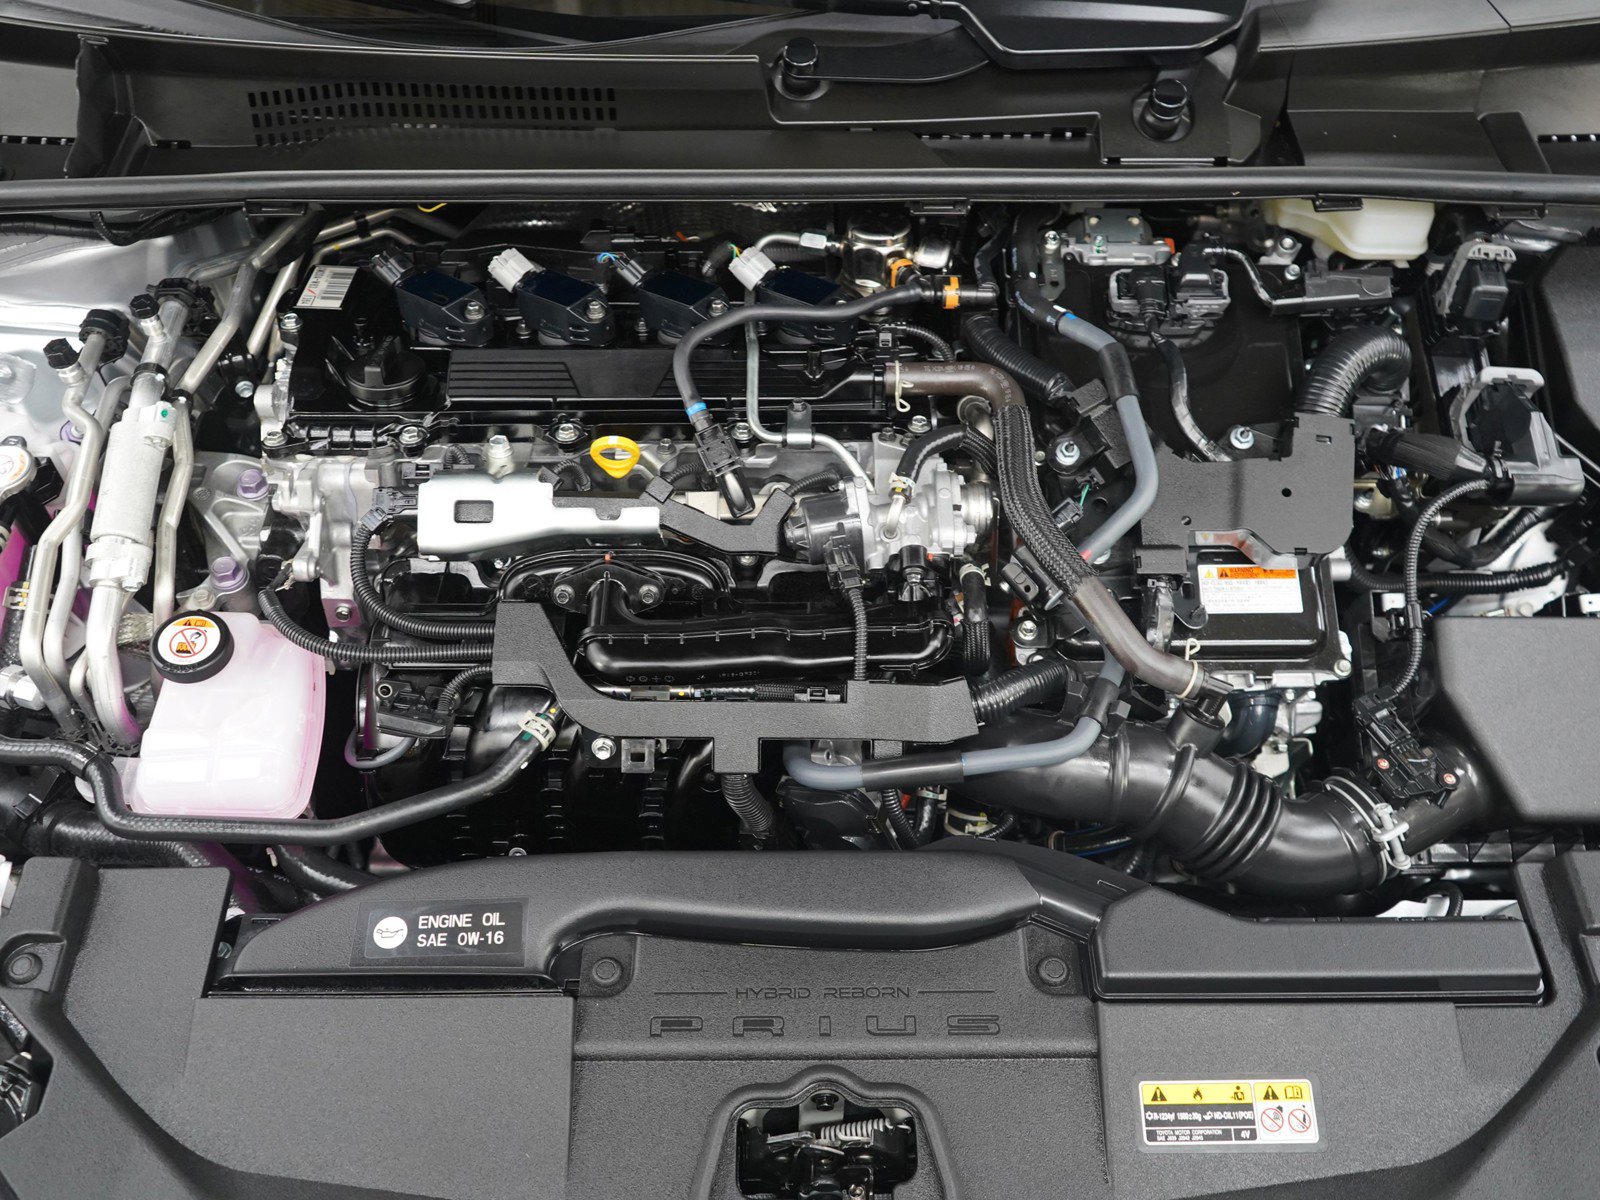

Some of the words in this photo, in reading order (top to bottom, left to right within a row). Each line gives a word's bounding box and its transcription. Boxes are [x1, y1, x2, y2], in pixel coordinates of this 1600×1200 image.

[418, 913, 473, 929] ENGINE
[482, 912, 506, 926] OIL
[416, 933, 448, 947] SAE
[457, 931, 504, 946] 0W-16
[735, 987, 811, 999] HYBRID
[823, 986, 910, 999] REBORN
[650, 1015, 1001, 1037] PRIUS
